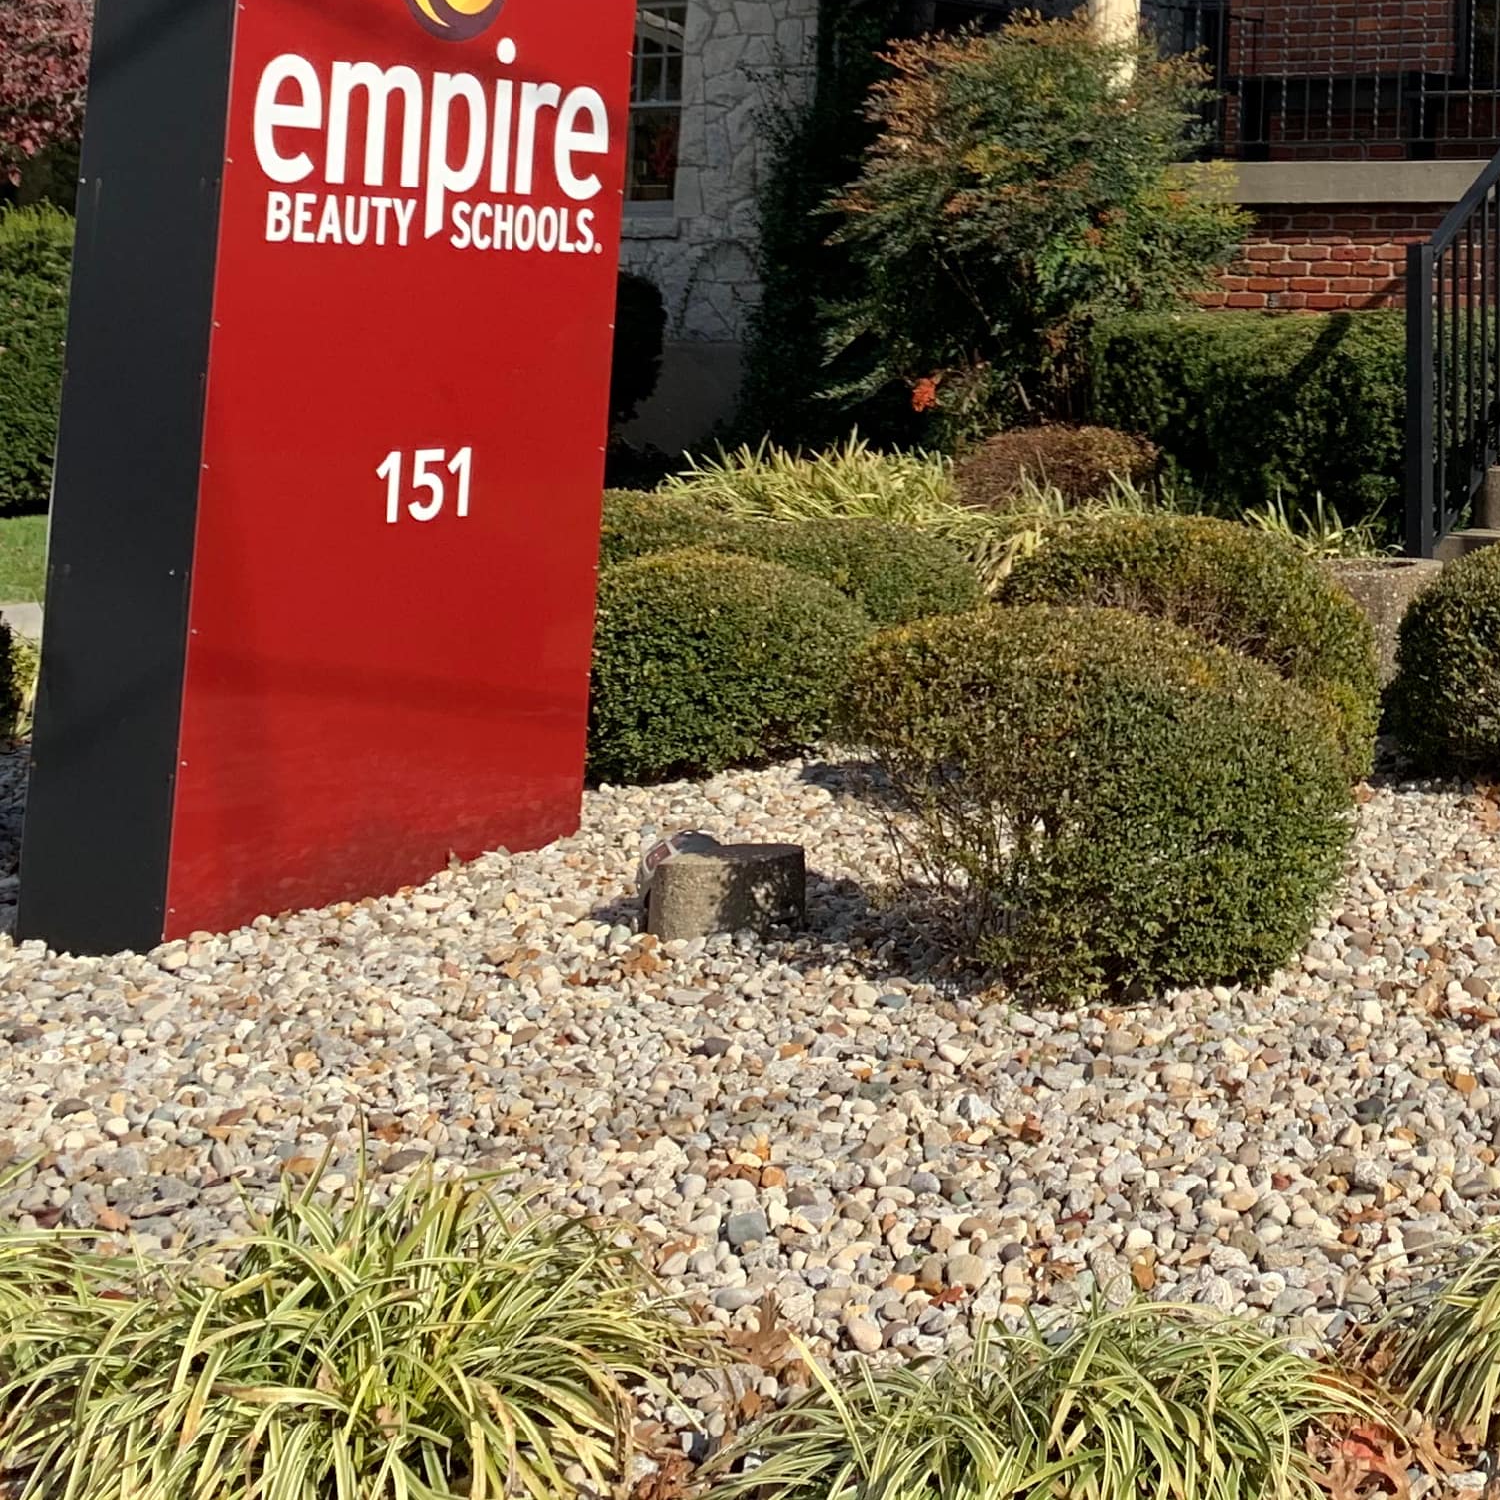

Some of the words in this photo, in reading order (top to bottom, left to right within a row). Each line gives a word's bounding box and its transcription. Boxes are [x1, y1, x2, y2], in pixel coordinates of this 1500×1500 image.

[253, 37, 609, 239] empire
[265, 191, 417, 246] BEAUTY
[376, 446, 472, 524] 151
